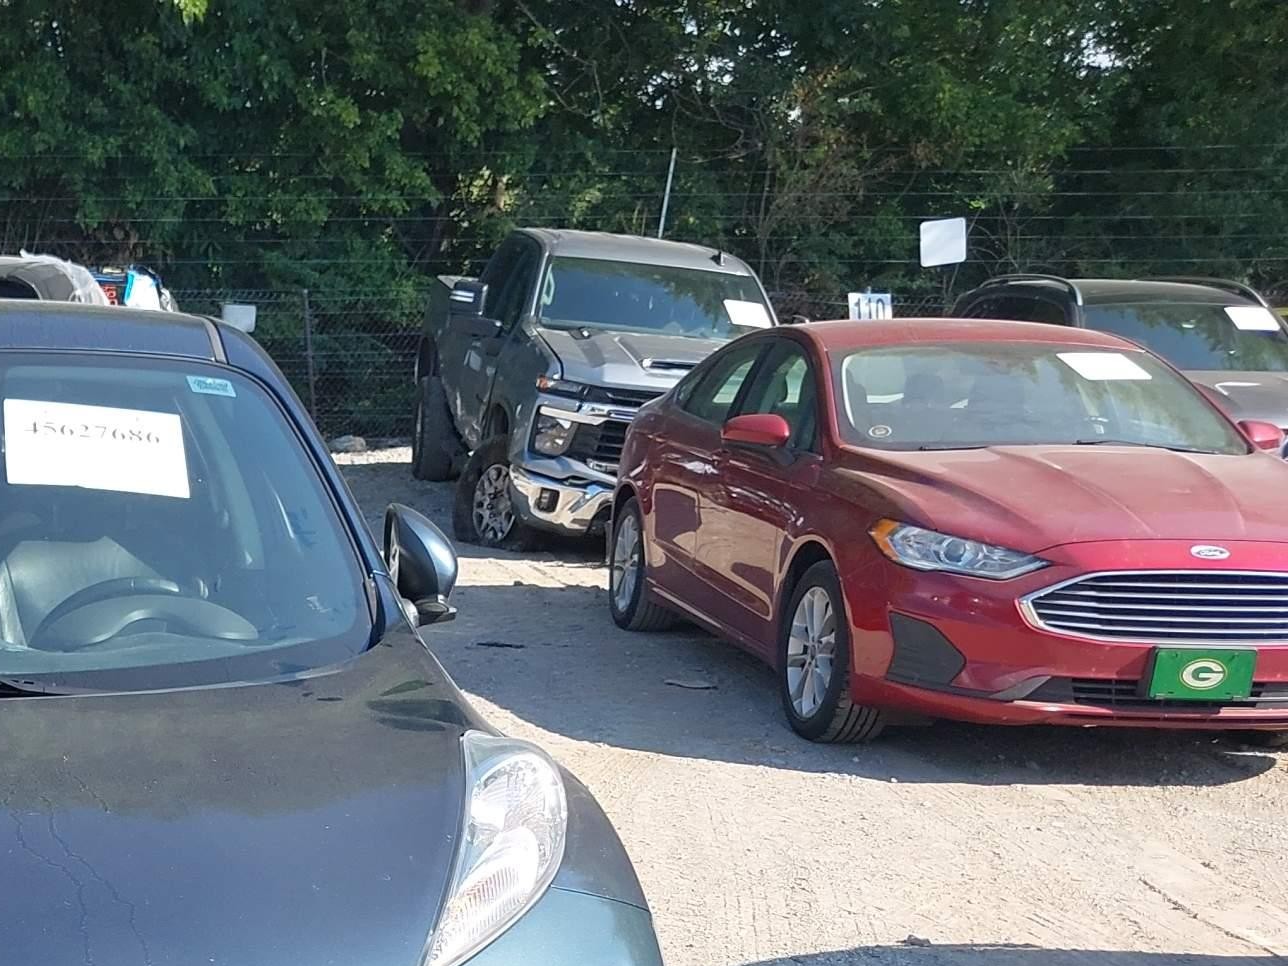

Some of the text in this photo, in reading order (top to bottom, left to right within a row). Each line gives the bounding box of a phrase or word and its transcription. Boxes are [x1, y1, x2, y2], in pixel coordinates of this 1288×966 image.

[854, 297, 885, 320] 110
[24, 421, 160, 443] 45627686
[1182, 661, 1224, 688] G
